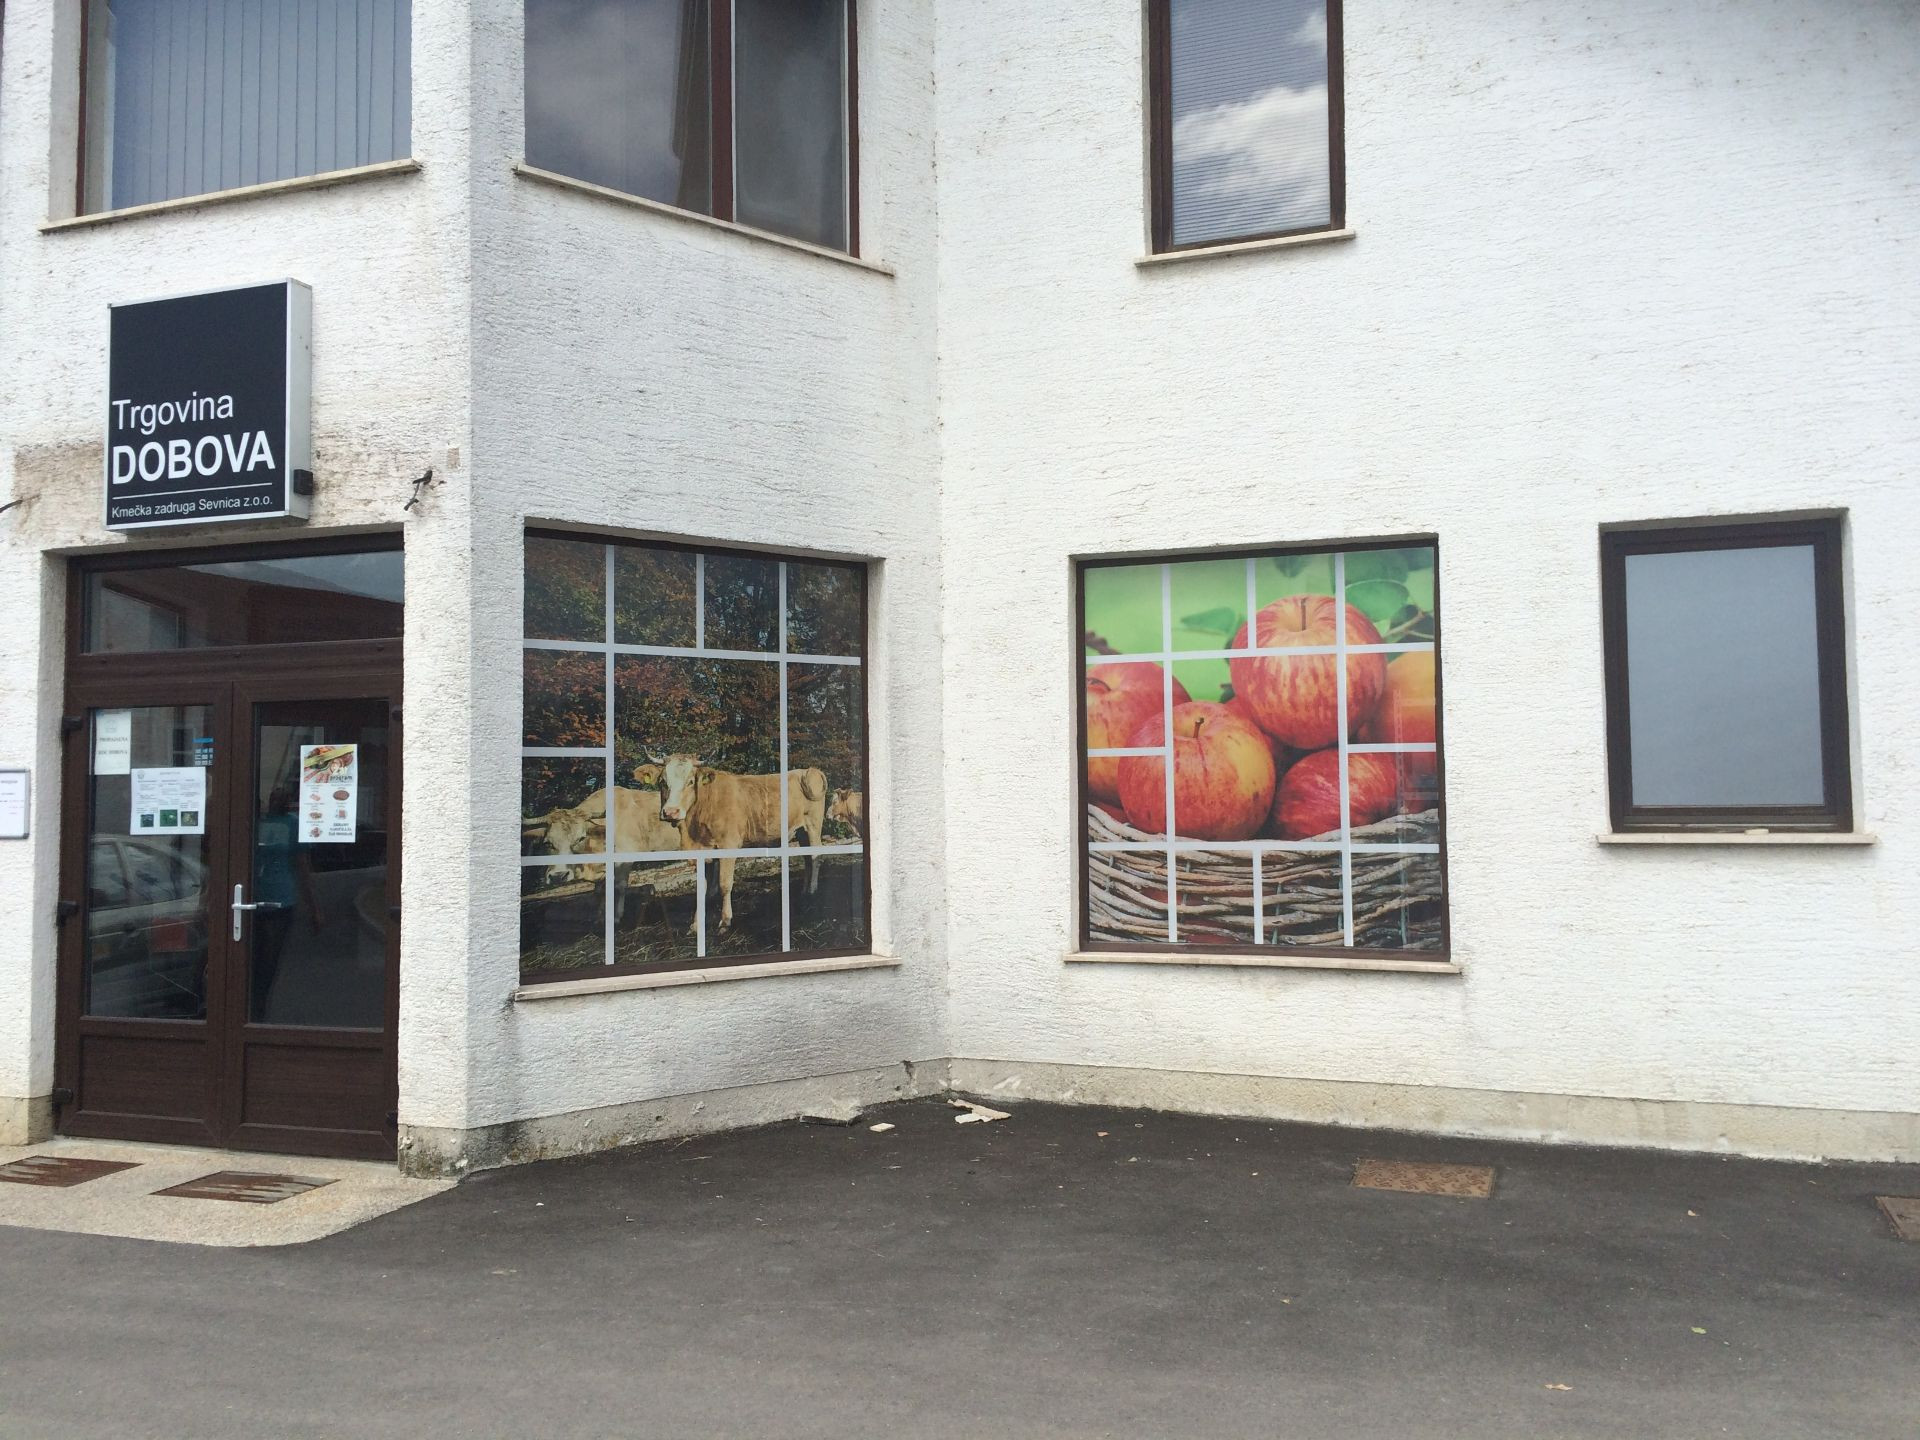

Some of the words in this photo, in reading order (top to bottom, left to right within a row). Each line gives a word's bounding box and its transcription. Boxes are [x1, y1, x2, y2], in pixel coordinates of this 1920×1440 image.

[112, 391, 234, 435] Trgovina
[112, 430, 276, 485] DOBOVA
[112, 504, 152, 518] Kmečka
[154, 501, 196, 515] zadruga
[199, 496, 241, 511] Sevnica
[243, 496, 273, 507] z.o.o.
